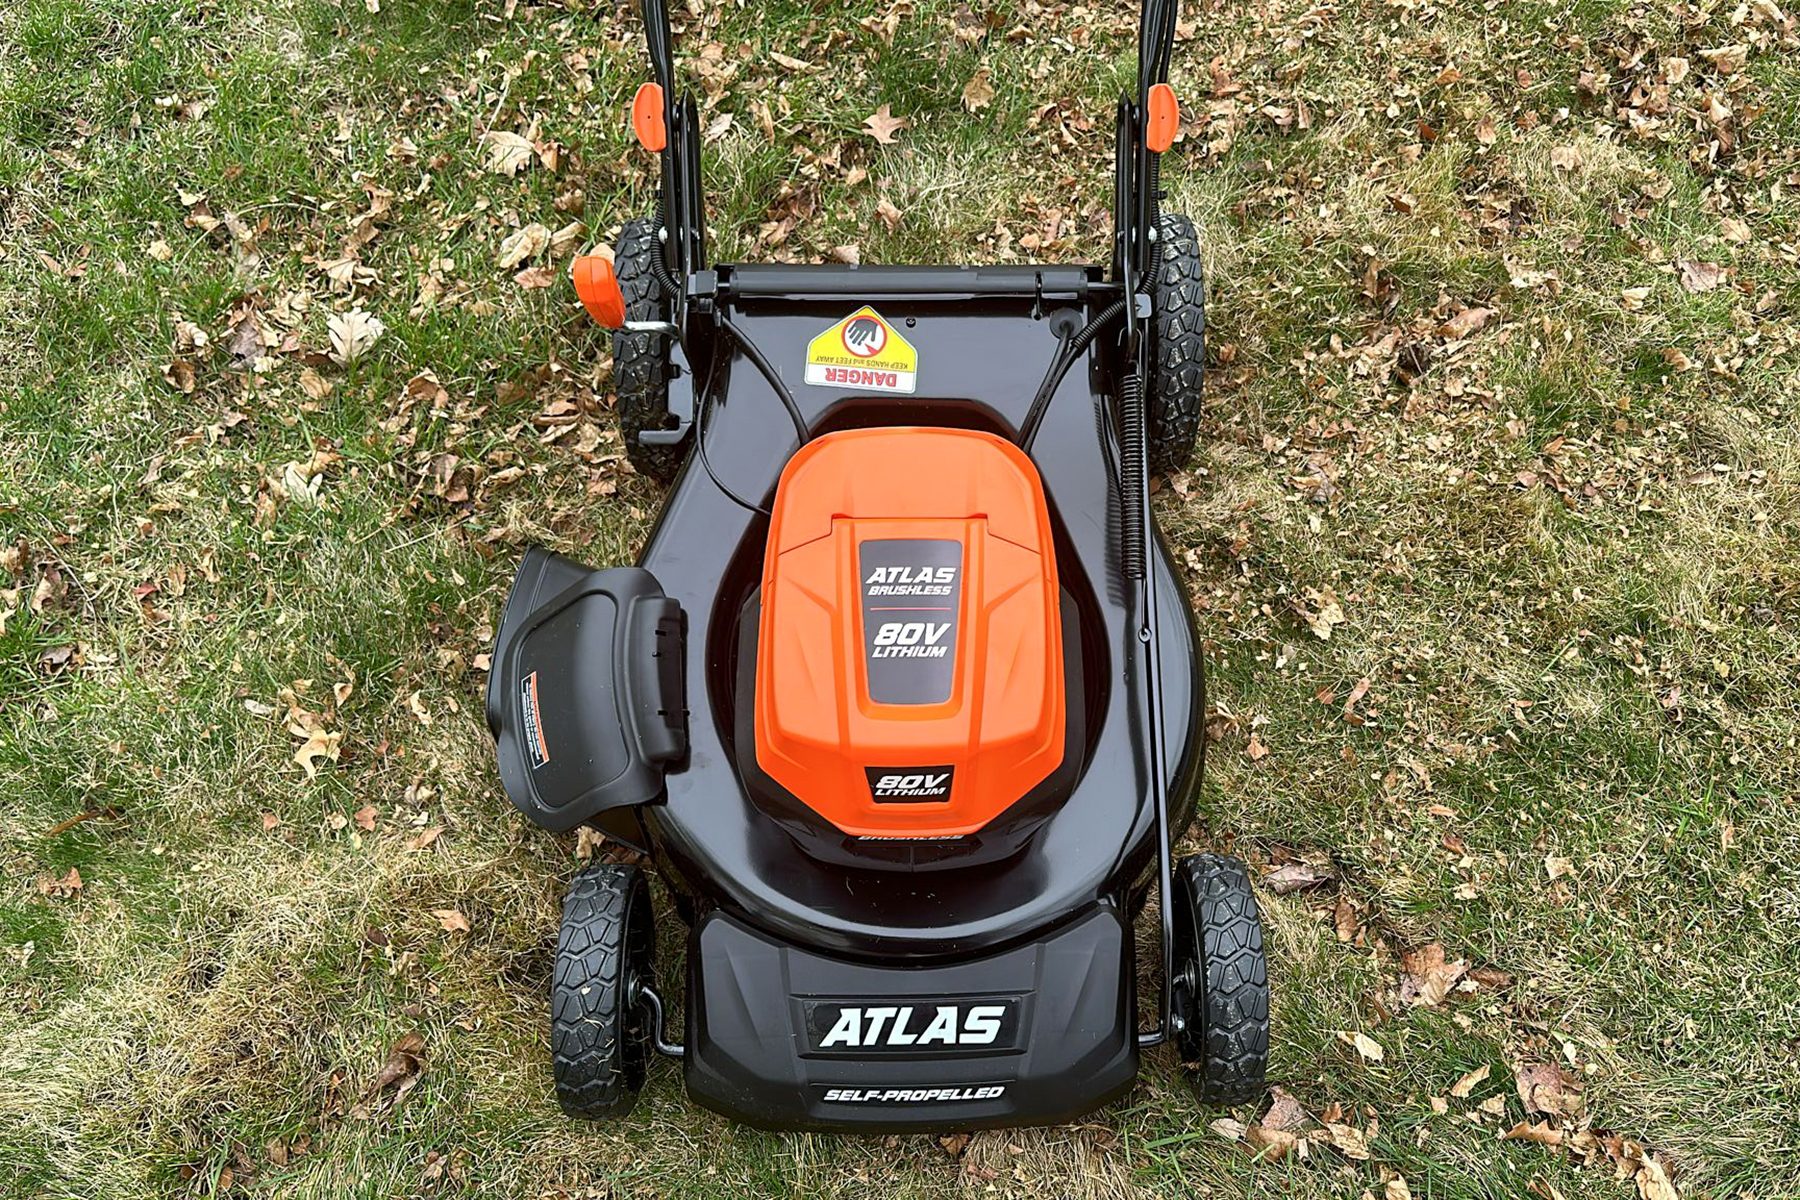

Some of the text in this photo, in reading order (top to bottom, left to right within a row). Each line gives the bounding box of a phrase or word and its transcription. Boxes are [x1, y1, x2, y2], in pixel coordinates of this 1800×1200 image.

[815, 355, 834, 363] AWAY
[866, 359, 889, 368] HANDS
[825, 368, 897, 387] DANGER
[865, 567, 956, 584] ATLAS
[868, 585, 952, 596] BRUSHLESS
[873, 623, 952, 646] 80V
[871, 646, 948, 658] LITHIUM
[875, 773, 950, 789] 80V
[875, 787, 946, 796] LITHIUM
[819, 1006, 1006, 1047] ATLAS
[823, 1086, 1005, 1102] SELF-PROPELLED
